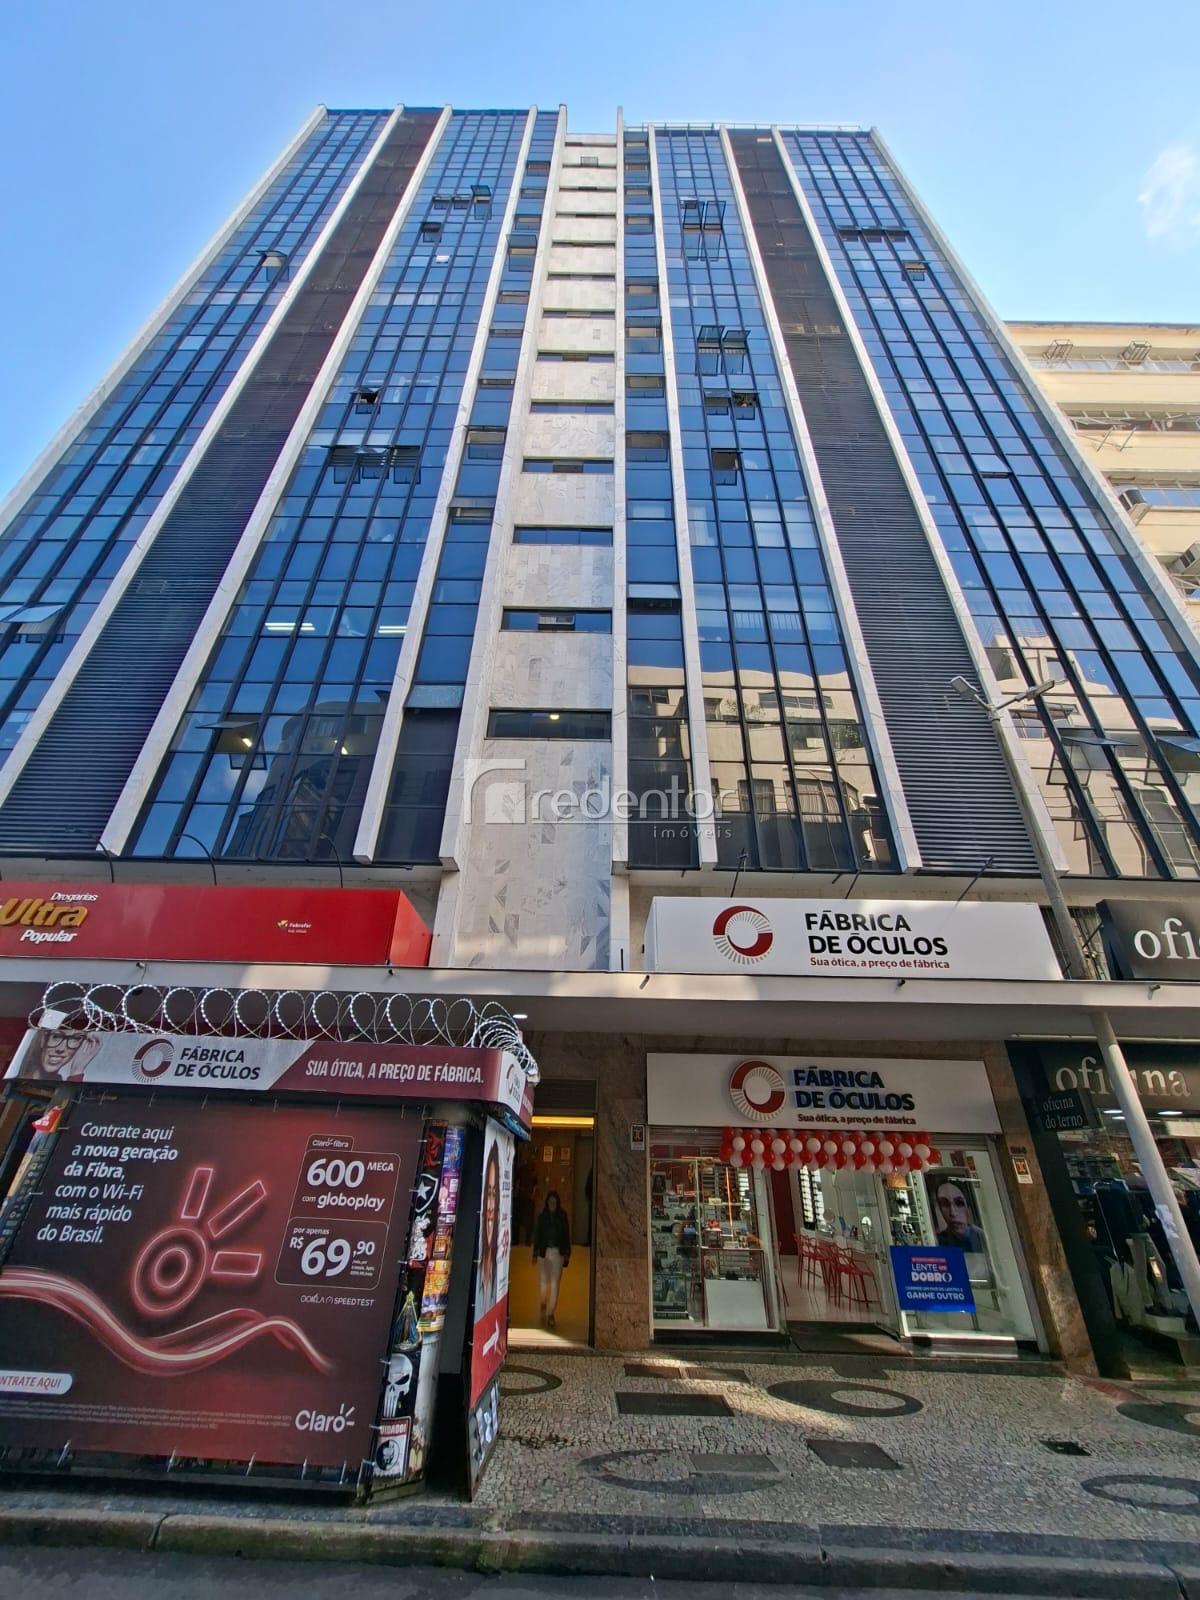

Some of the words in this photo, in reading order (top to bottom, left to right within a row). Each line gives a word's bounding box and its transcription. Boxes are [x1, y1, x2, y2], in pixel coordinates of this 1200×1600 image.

[50, 892, 98, 903] Drogarias
[0, 898, 88, 927] Ultra
[20, 929, 78, 944] Popular
[808, 935, 842, 954] DE
[810, 957, 830, 967] Sua
[831, 957, 860, 968] ótica,
[868, 959, 898, 969] preço
[899, 959, 912, 968] de
[913, 959, 950, 969] fábrica
[174, 1064, 196, 1077] DE
[305, 1060, 328, 1077] SUA
[330, 1058, 365, 1079] ÓTICA,
[368, 1063, 376, 1079] A
[378, 1063, 415, 1083] PREÇO
[417, 1065, 431, 1080] DE
[434, 1063, 485, 1084] FÁBRICA.
[794, 1091, 826, 1109] DE
[798, 1113, 814, 1122] Sua
[815, 1114, 839, 1123] ótica,
[847, 1115, 872, 1125] preço
[873, 1116, 884, 1124] de
[884, 1116, 917, 1125] fábrica
[1045, 1115, 1056, 1129] do
[81, 1122, 141, 1139] Contrate
[142, 1126, 175, 1143] aqui
[71, 1144, 81, 1156] a
[83, 1144, 119, 1157] nova
[119, 1145, 179, 1163] geração
[64, 1161, 83, 1177] da
[85, 1162, 126, 1181] Fibra,
[306, 1158, 365, 1188] 600
[367, 1162, 395, 1172] MEGA
[55, 1184, 86, 1198] com
[88, 1186, 99, 1199] o
[102, 1184, 144, 1200] Wi-Fi
[317, 1192, 385, 1212] globoplay
[46, 1203, 82, 1219] mais
[83, 1203, 132, 1224] rápido
[37, 1224, 57, 1240] do
[60, 1225, 103, 1243] Brasil.
[293, 1227, 306, 1235] por
[306, 1228, 330, 1236] apenas
[912, 1263, 938, 1271] LENTE
[911, 1272, 952, 1282] DOBRO
[334, 1297, 376, 1307] SPEEDTEST
[906, 1291, 936, 1300] GANHE
[37, 1377, 61, 1390] AQUI
[295, 1406, 350, 1432] Claro
